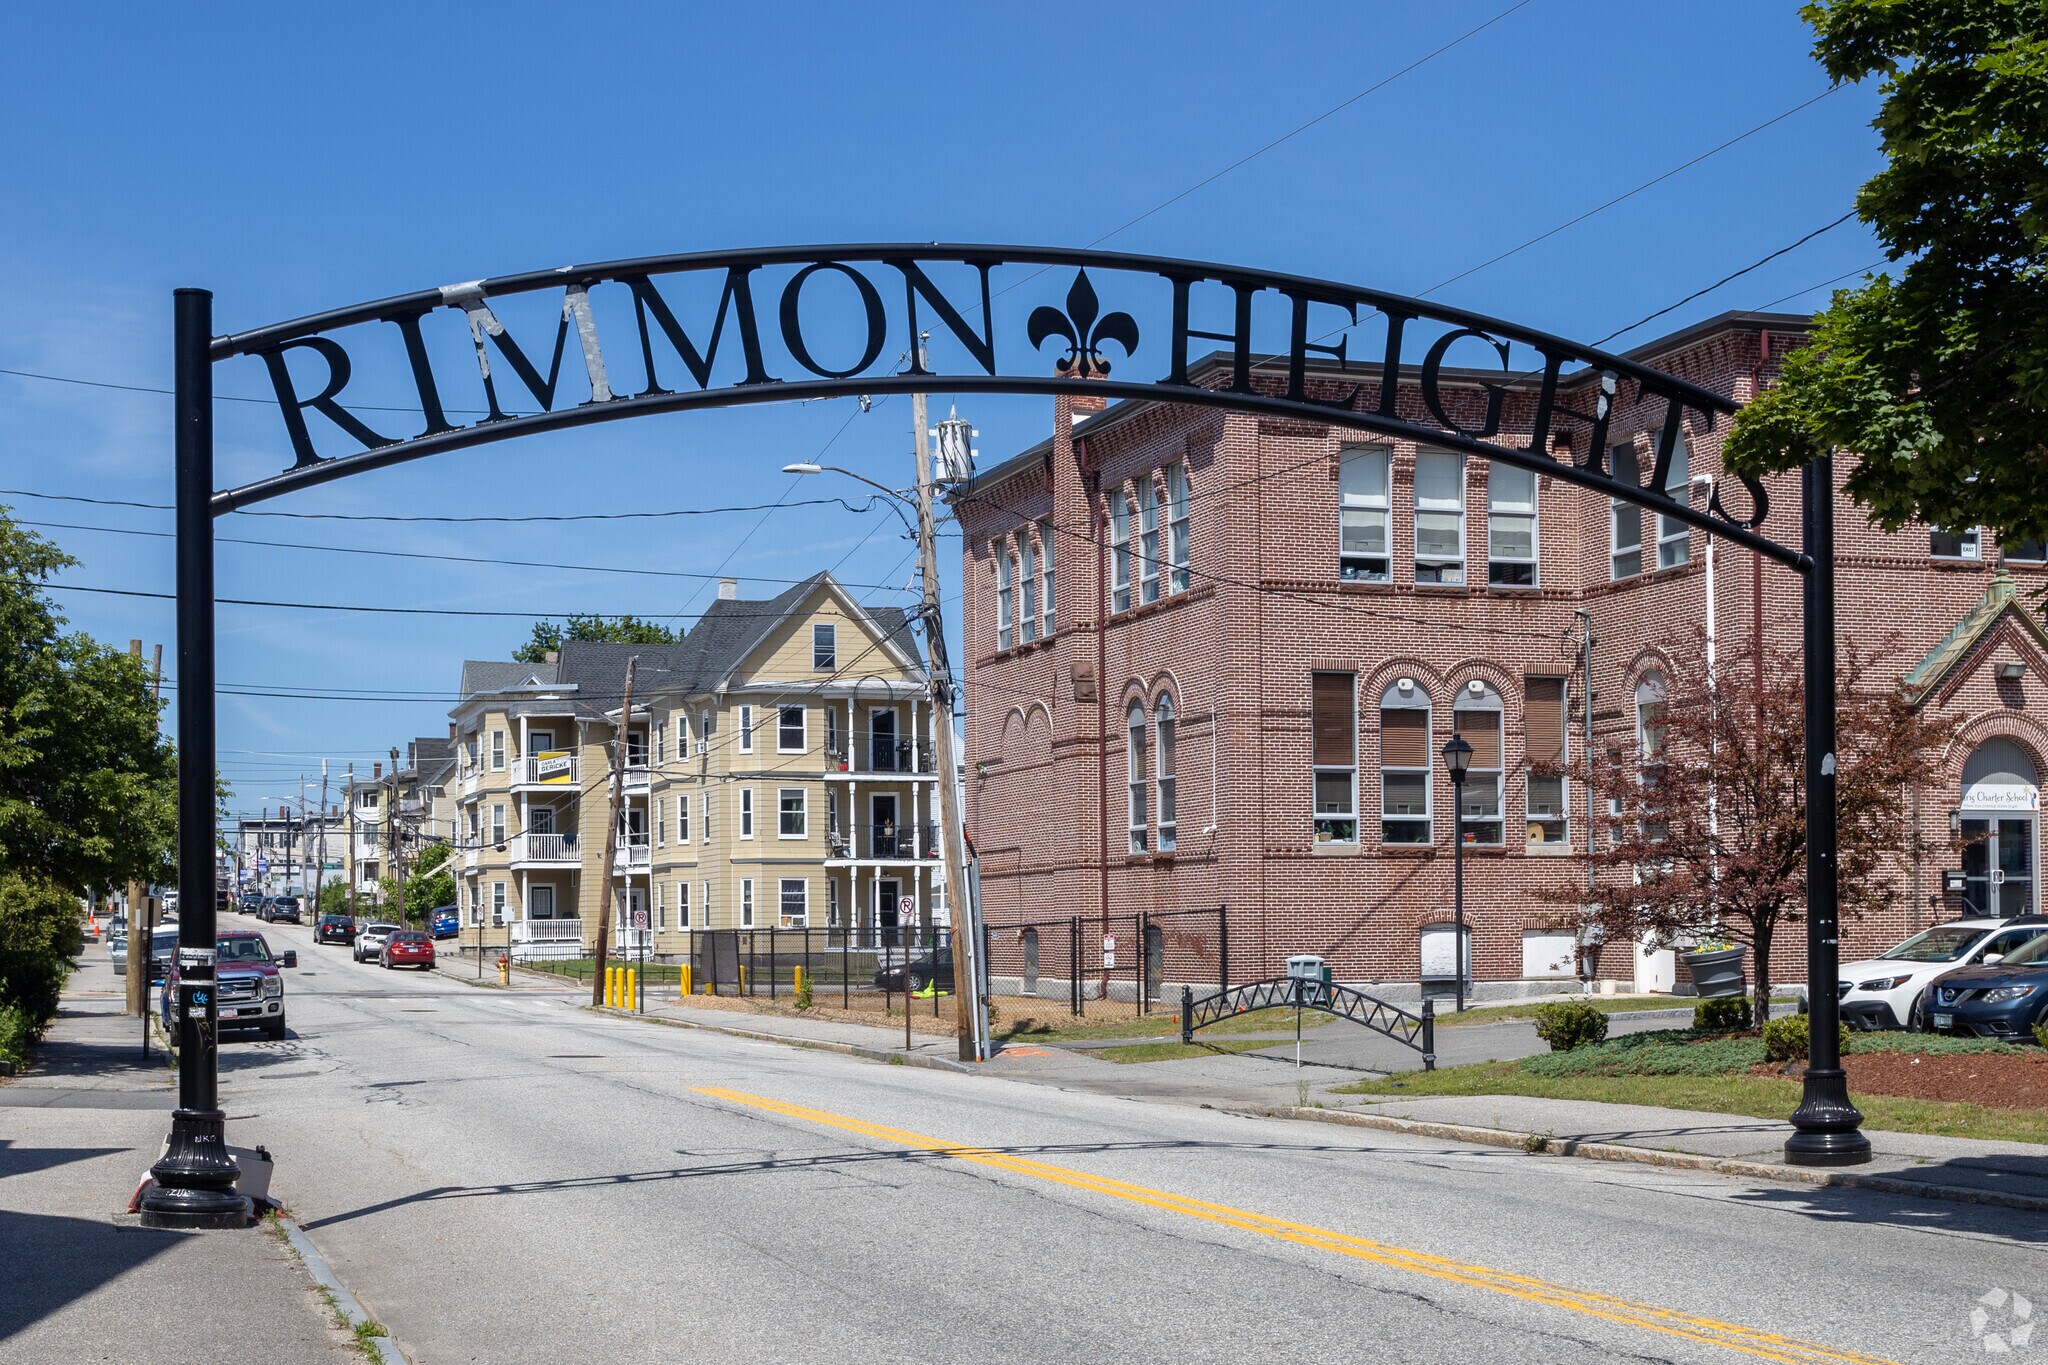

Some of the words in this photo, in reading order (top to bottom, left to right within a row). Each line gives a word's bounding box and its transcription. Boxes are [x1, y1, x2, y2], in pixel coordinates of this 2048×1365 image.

[243, 260, 1003, 474] RIMMON
[541, 761, 567, 772] GERICKE
[1976, 791, 2004, 803] Charter
[2006, 791, 2028, 803] School
